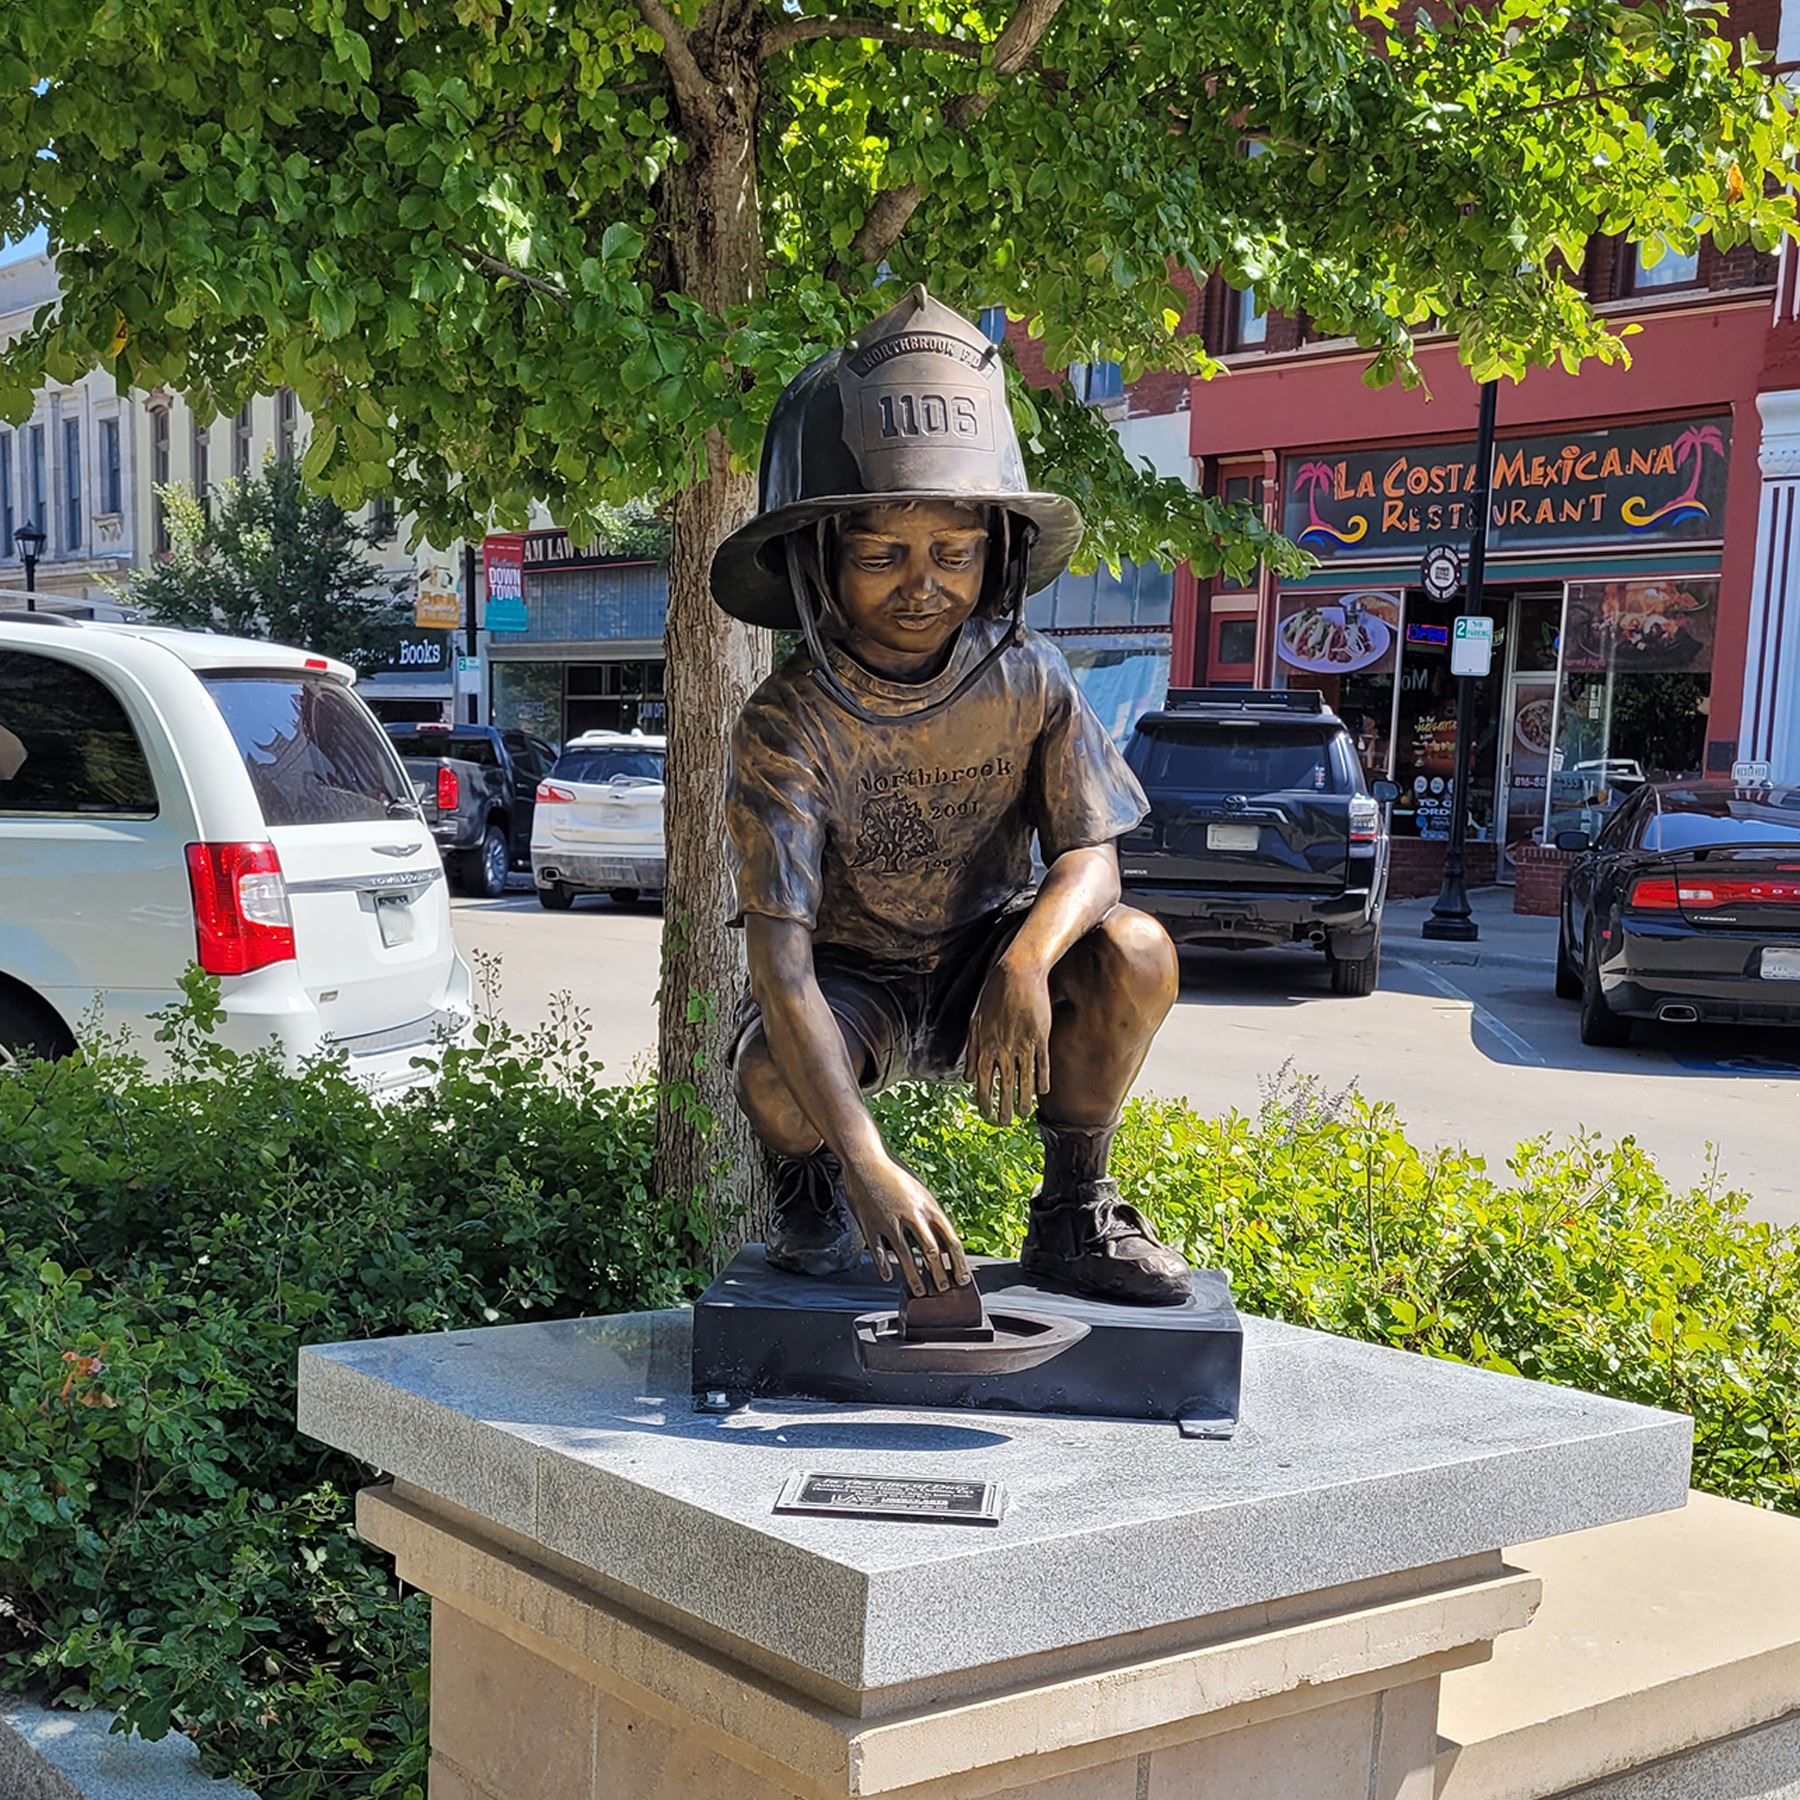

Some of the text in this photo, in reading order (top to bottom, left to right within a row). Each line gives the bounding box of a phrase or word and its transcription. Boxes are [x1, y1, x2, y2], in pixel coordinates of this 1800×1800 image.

[863, 335, 954, 367] NORTHBROOK
[879, 394, 978, 438] 1106
[1334, 461, 1376, 500] LA
[1382, 493, 1607, 533] RESTURANT
[547, 537, 574, 560] LAW
[489, 567, 521, 585] DOWN
[489, 584, 521, 601] TOWN
[1409, 626, 1447, 642] OPEN
[1457, 621, 1466, 636] 2
[400, 639, 440, 664] Books
[855, 758, 1014, 793] Northbrook
[930, 801, 979, 820] 2001
[1419, 799, 1439, 808] TO
